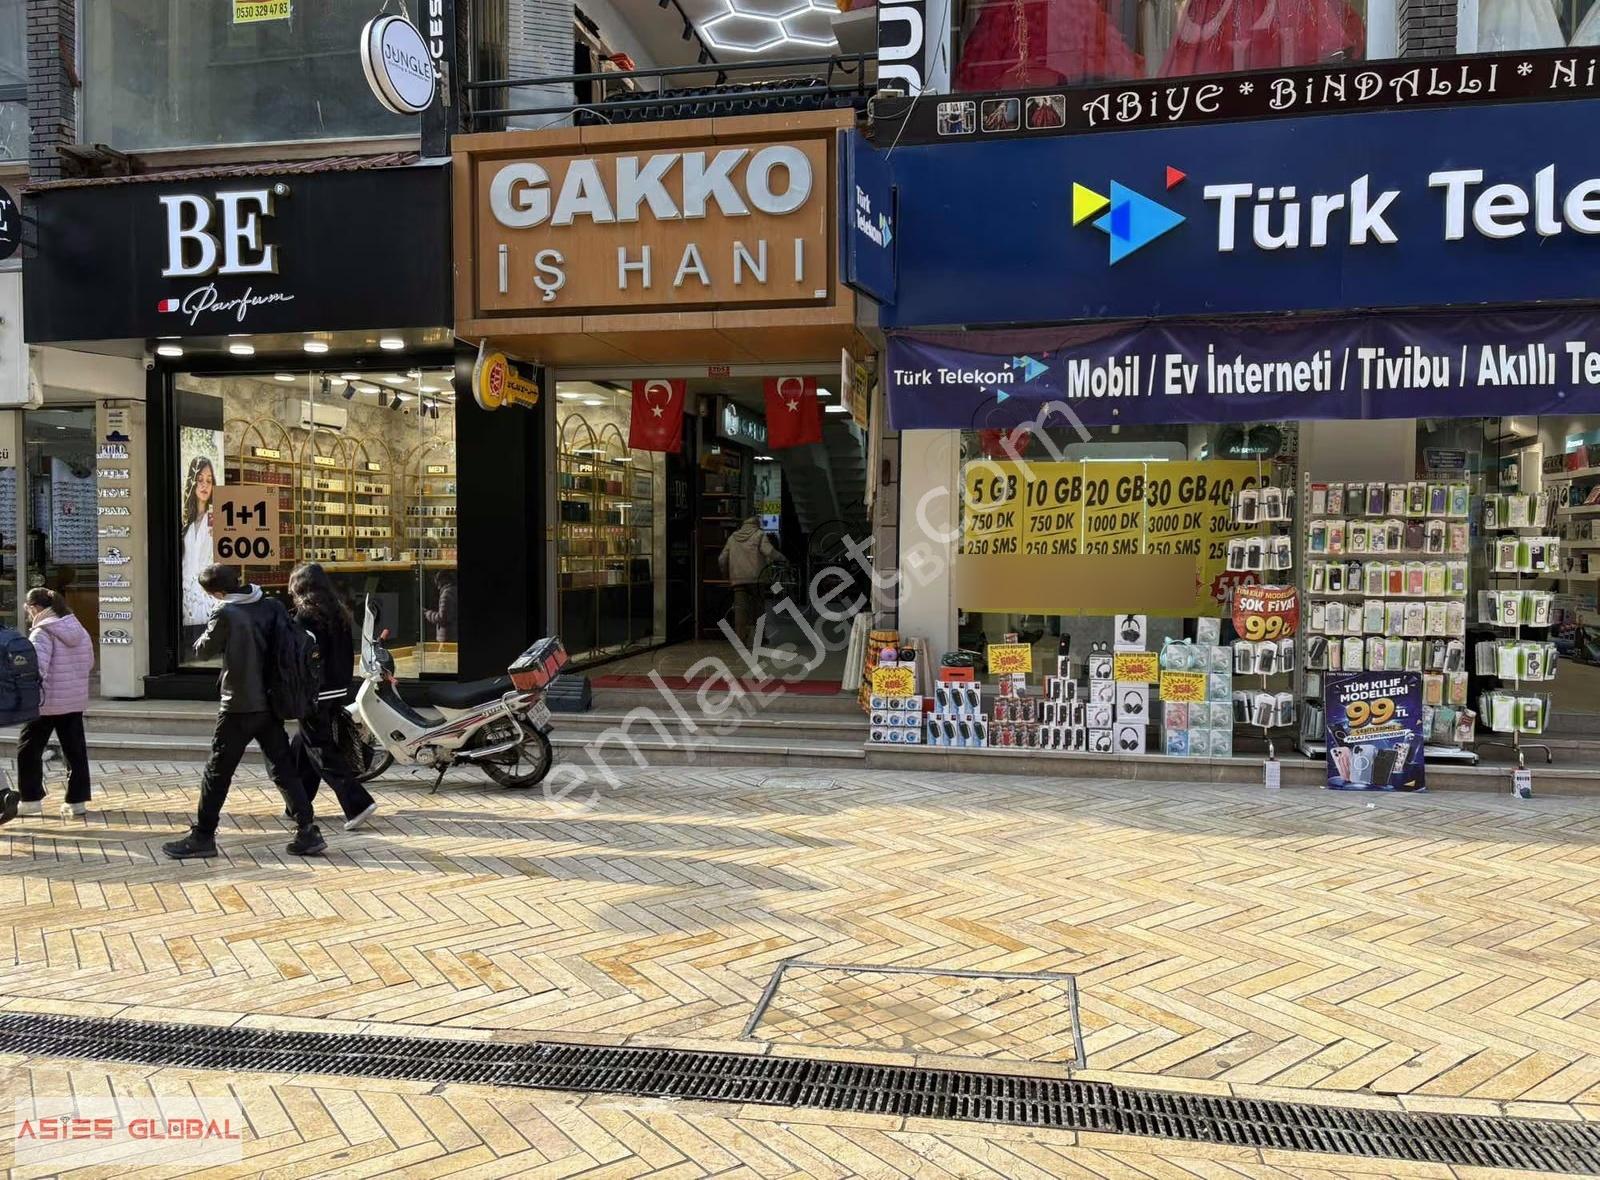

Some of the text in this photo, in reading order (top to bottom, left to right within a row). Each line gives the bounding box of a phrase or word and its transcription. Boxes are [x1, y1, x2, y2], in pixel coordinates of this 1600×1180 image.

[255, 4, 268, 17] 329
[489, 145, 813, 229] GAKKO
[1204, 163, 1600, 252] Türk Tele
[498, 238, 805, 302] İŞ HANI
[182, 282, 295, 327] Parfum
[894, 367, 1015, 387] Türk Telekom
[1068, 355, 1140, 398] Mobil
[1164, 352, 1199, 395] Ev
[1207, 343, 1331, 394] İnterneti
[1358, 345, 1450, 390] Tivibu
[1477, 342, 1556, 387] Akıllı
[1565, 341, 1600, 385] Te
[973, 475, 1018, 503] 5 GB
[1026, 475, 1083, 507] 10 GB
[1085, 475, 1145, 507] 20 GB
[1147, 475, 1208, 507] 30 GB
[221, 500, 267, 527] 1+1
[971, 511, 1015, 531] 750 DK
[1030, 512, 1075, 532] 750 DK
[1087, 512, 1140, 532] 1000 DK
[1148, 512, 1202, 533] 3000 DK
[968, 537, 1017, 554] 250 SMS
[1051, 538, 1077, 554] SMS
[1111, 538, 1138, 554] SMS
[1174, 538, 1201, 555] SMS
[1208, 542, 1229, 560] 25
[1239, 597, 1265, 612] ŞOK
[1340, 684, 1409, 702] MODELLERİ
[1344, 678, 1401, 693] TÜM KILIF
[1345, 697, 1396, 728] 99
